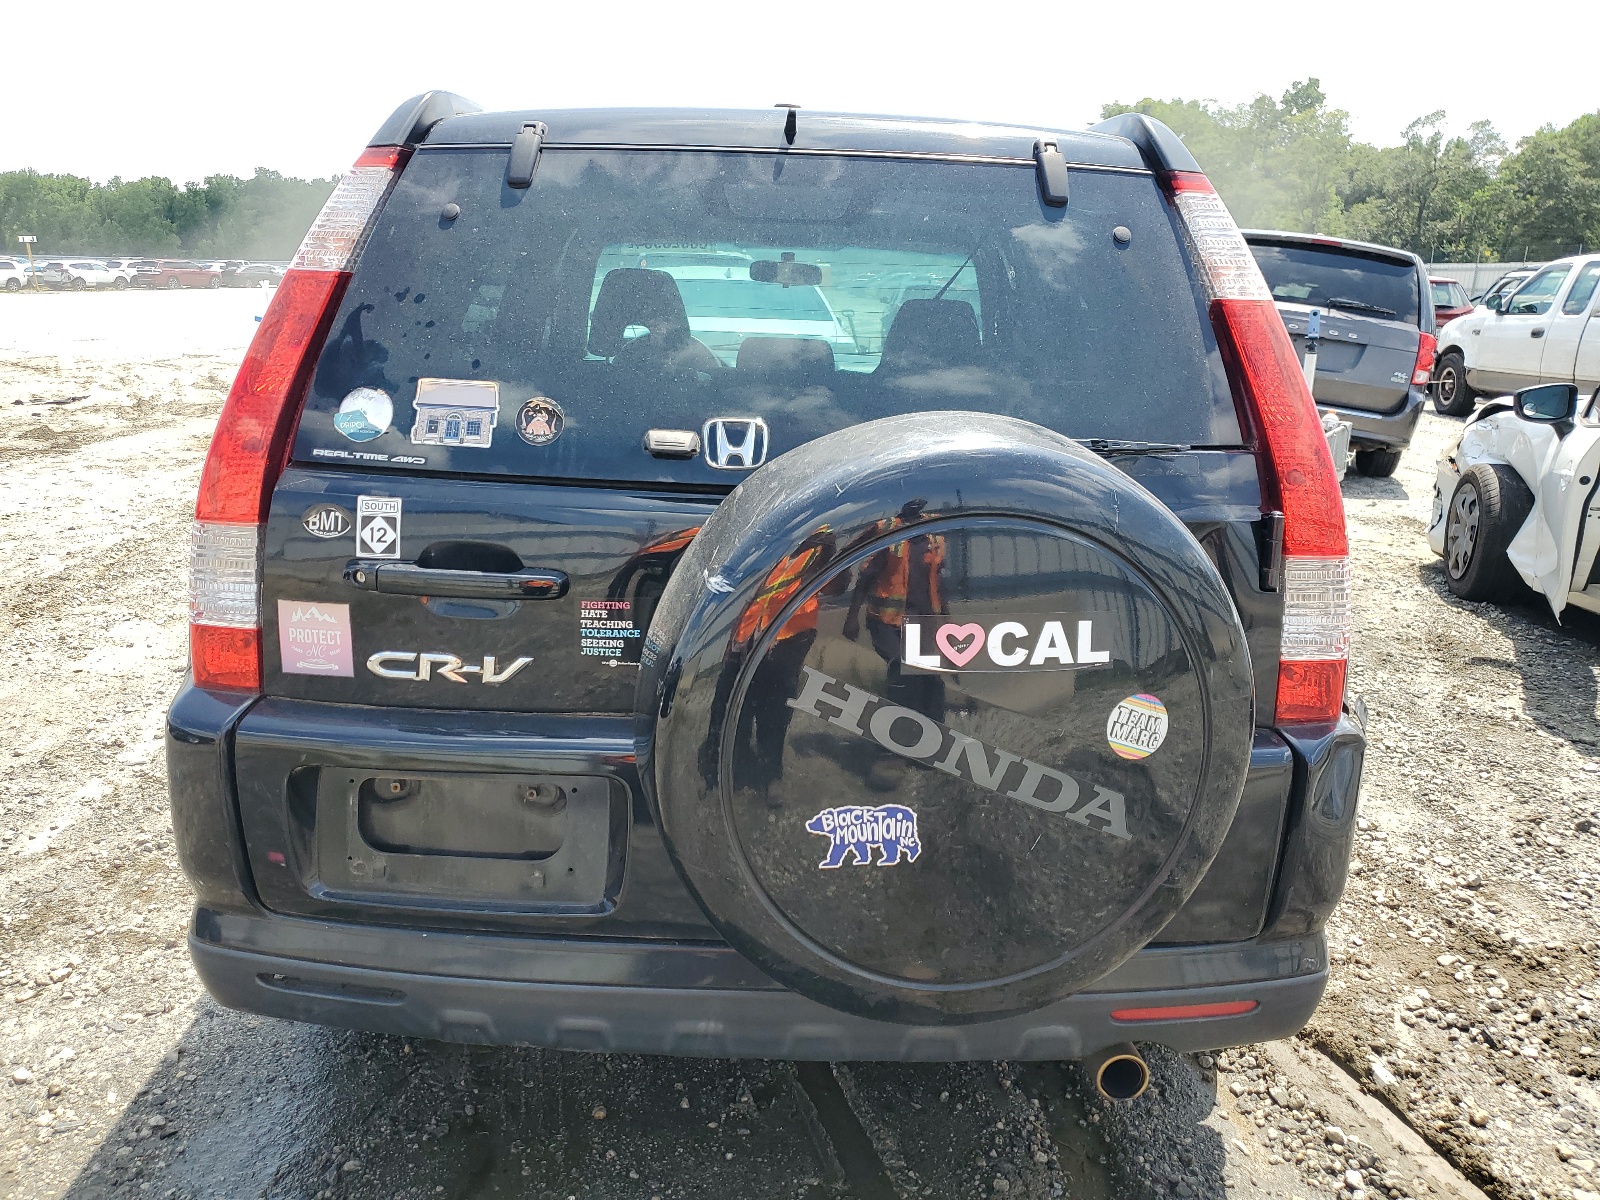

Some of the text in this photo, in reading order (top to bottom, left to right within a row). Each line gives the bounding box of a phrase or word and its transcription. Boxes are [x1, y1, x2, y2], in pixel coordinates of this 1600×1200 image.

[390, 456, 425, 464] 4WD
[364, 502, 396, 511] SOUTH
[309, 511, 342, 532] BMT
[369, 526, 387, 543] 12
[581, 601, 631, 609] FIGHTING
[581, 610, 608, 618] HATE
[580, 620, 633, 628] TEACHING
[289, 628, 341, 645] PROTECT
[580, 629, 640, 637] TOLERANCE
[581, 639, 624, 647] SEEKING
[306, 644, 326, 657] NC
[581, 648, 622, 656] JUSTICE
[366, 651, 535, 684] CR-V
[1118, 705, 1162, 733] TEAM
[1110, 720, 1160, 749] MARG
[785, 664, 1133, 841] HONDA
[821, 810, 875, 832] Black
[835, 812, 913, 844] Mountain
[900, 837, 916, 846] NC
